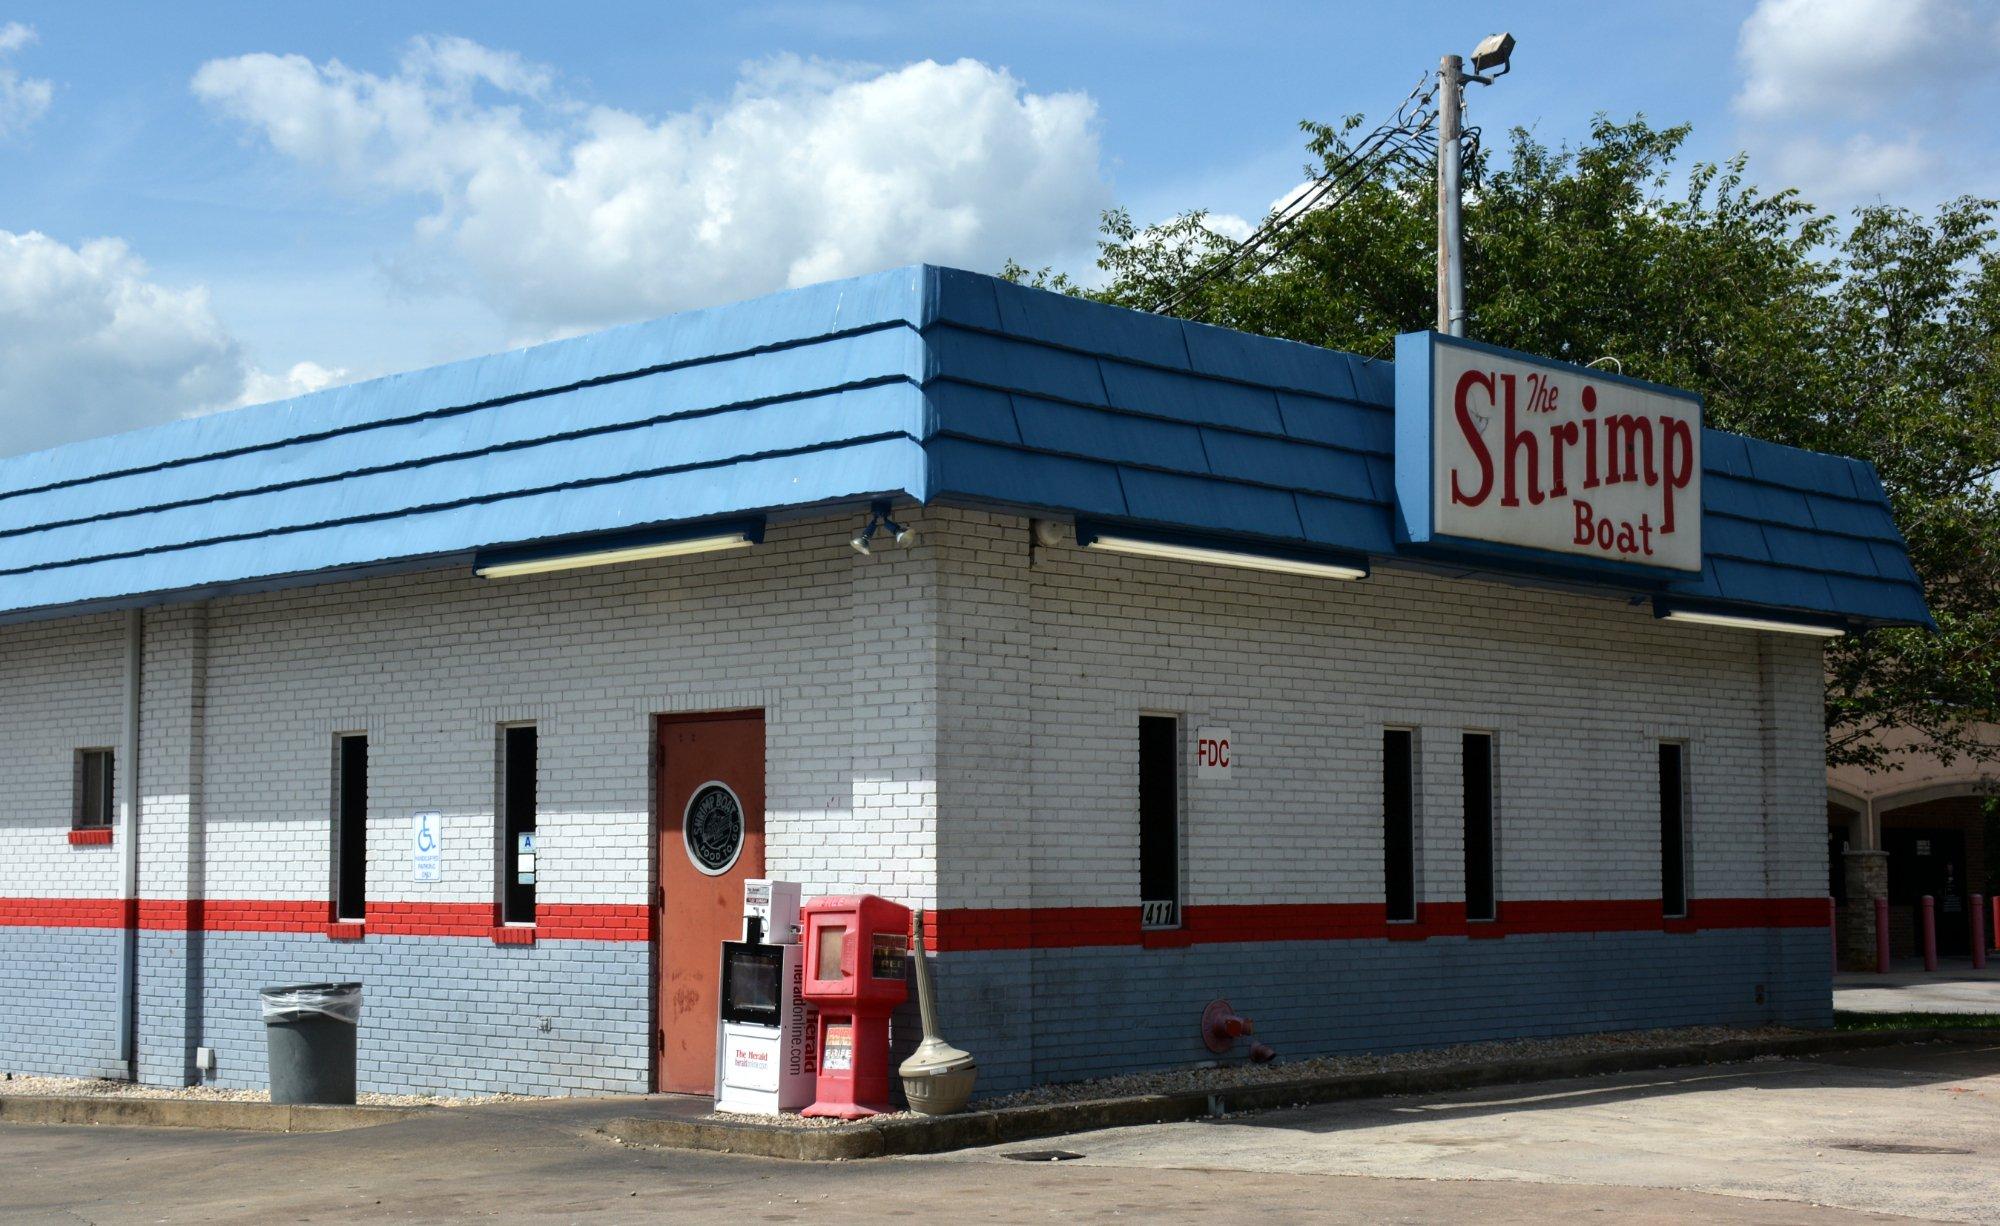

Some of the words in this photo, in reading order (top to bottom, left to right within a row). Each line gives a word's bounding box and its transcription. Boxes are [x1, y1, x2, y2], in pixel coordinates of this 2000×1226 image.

[1526, 373, 1558, 413] The
[1452, 369, 1693, 534] Shrimp
[1572, 500, 1653, 556] Boat
[1198, 739, 1230, 767] FDC
[693, 795, 715, 834] SHRIMP
[716, 794, 736, 813] BOAT
[524, 836, 531, 847] A
[700, 845, 720, 860] FOOD
[723, 845, 733, 857] TO
[732, 824, 739, 841] GO
[1142, 903, 1172, 924] 411
[736, 1050, 746, 1058] The
[748, 1051, 768, 1061] Herald
